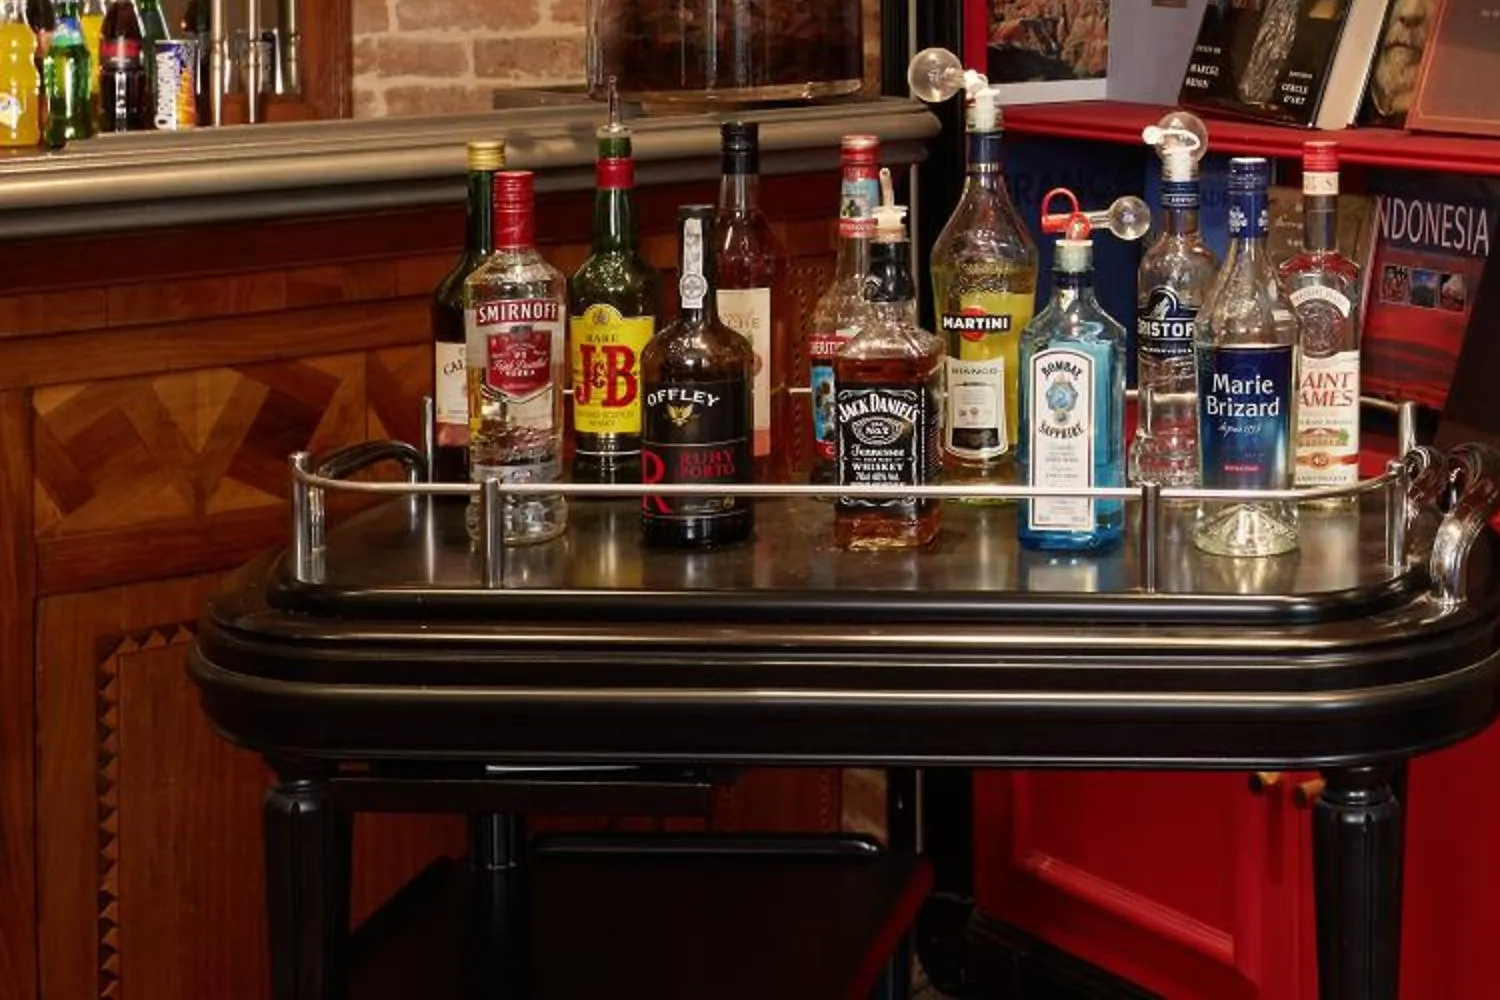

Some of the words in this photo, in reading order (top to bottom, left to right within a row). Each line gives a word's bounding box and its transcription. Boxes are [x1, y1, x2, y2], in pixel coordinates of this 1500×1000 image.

[1377, 195, 1490, 257] NDONESIA
[479, 303, 557, 323] SMIRNOFF
[943, 316, 1008, 330] MARTINI
[1137, 321, 1194, 337] RISTOF
[576, 343, 638, 408] J&B
[1040, 359, 1083, 381] BOMBAY
[1301, 371, 1354, 389] AINT
[1212, 373, 1274, 395] Marie
[647, 388, 721, 407] OFFLEY
[1206, 395, 1280, 418] Brizard
[1299, 389, 1353, 408] AMES
[838, 395, 869, 423] JACK
